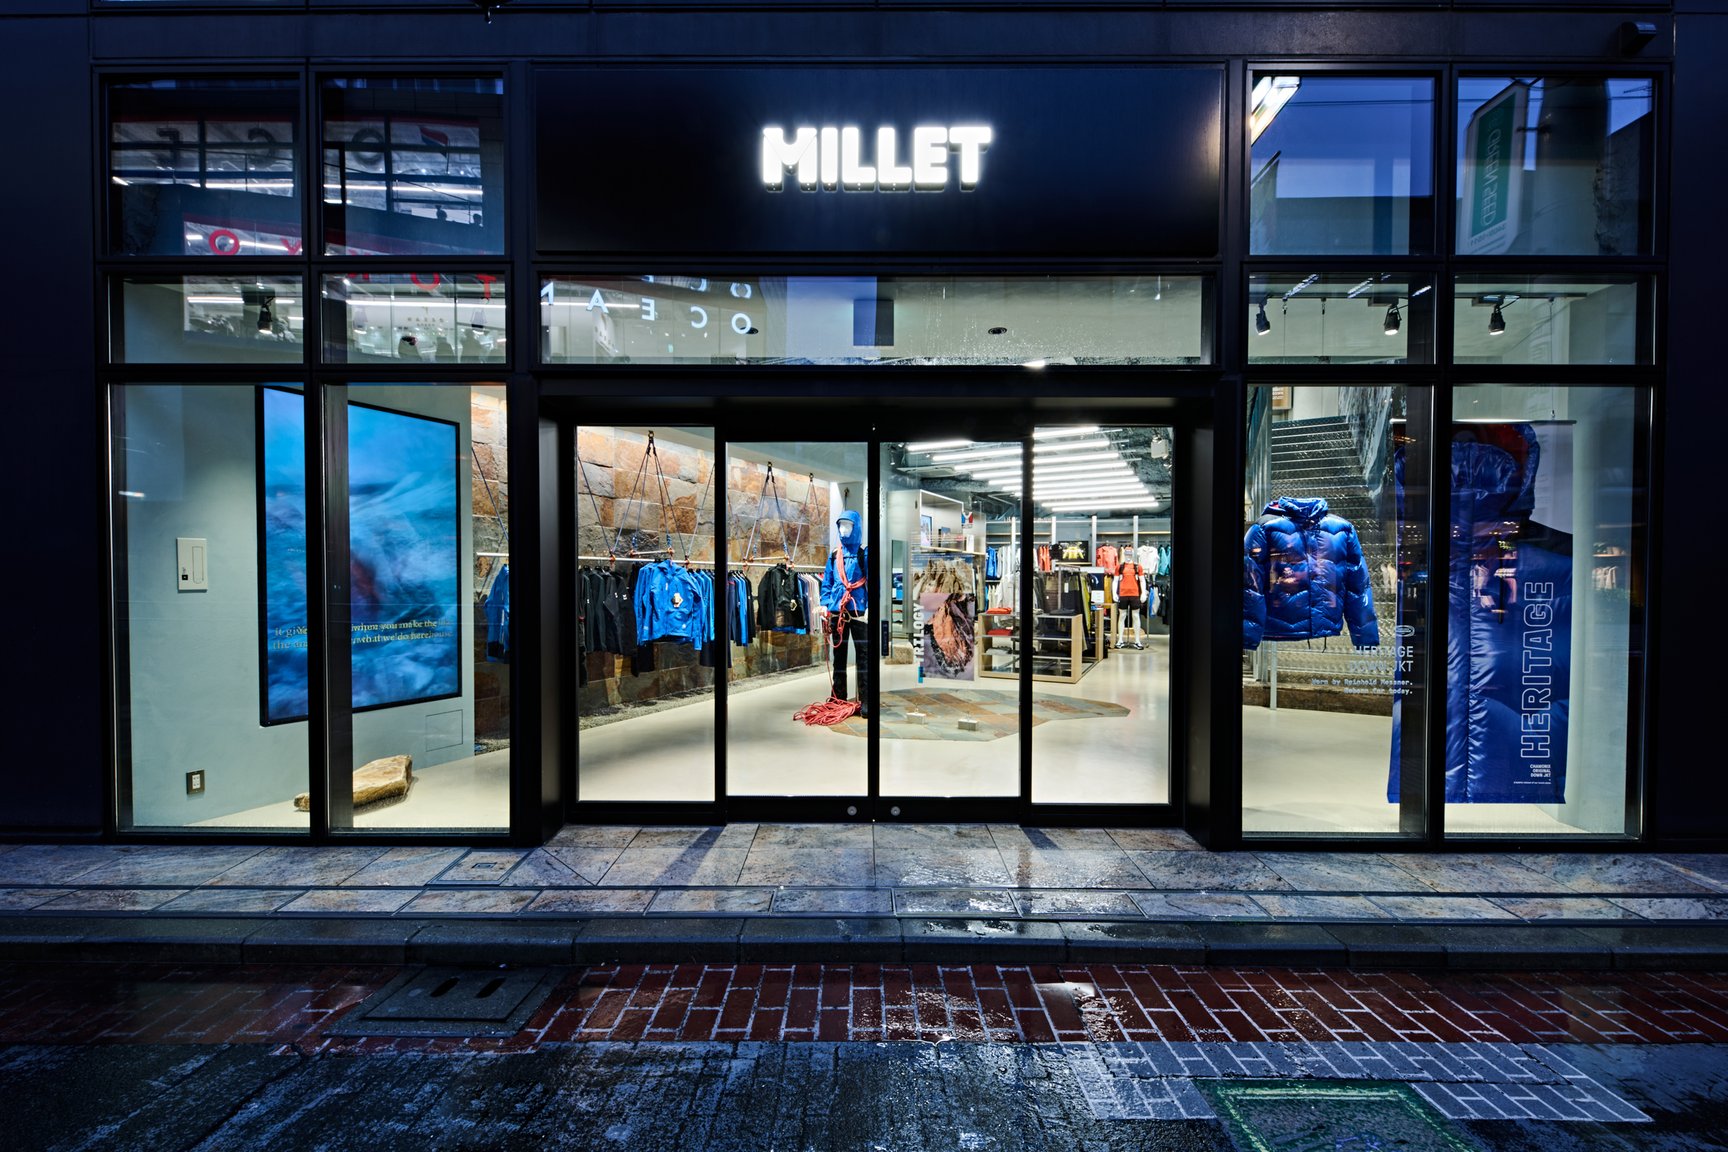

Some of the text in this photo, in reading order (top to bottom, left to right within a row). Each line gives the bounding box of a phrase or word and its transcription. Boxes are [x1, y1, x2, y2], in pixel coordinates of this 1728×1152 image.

[762, 126, 992, 190] MILLET
[913, 603, 924, 663] TRILOGY
[1354, 645, 1414, 658] HERITAGE
[1392, 660, 1414, 673] JKT
[1521, 581, 1554, 759] HERITAGE
